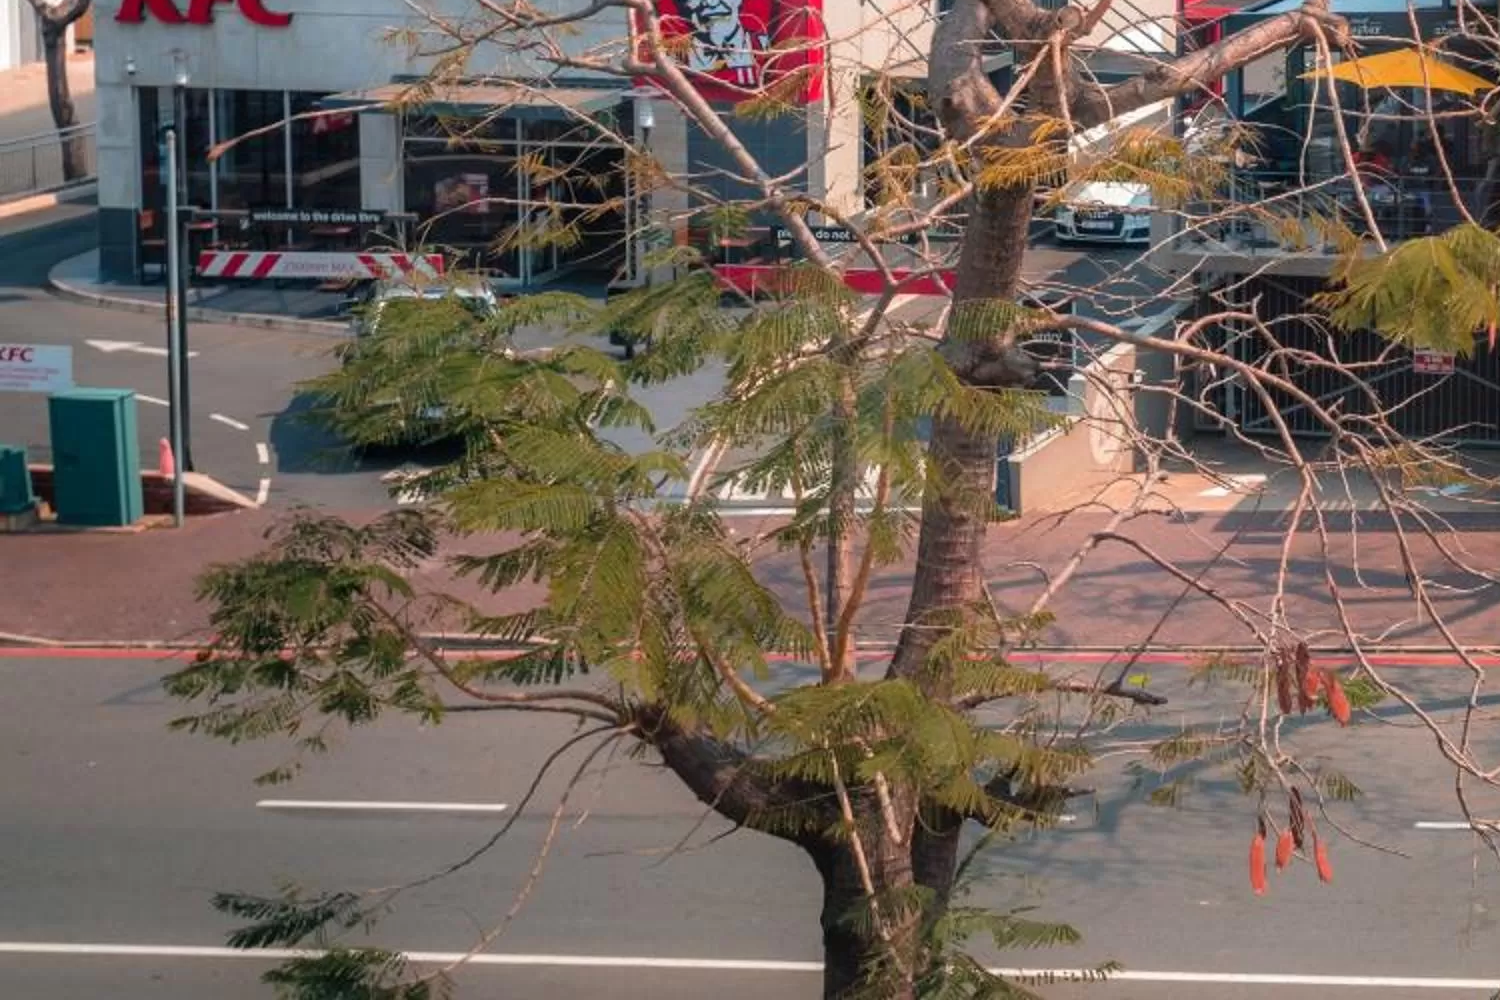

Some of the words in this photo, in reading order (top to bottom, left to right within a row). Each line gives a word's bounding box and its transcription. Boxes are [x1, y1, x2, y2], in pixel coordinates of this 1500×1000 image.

[253, 210, 298, 221] welcome
[300, 210, 310, 222] to
[312, 210, 329, 222] the
[331, 210, 356, 223] drive
[358, 211, 380, 223] thru
[815, 230, 830, 240] do
[832, 230, 850, 240] not
